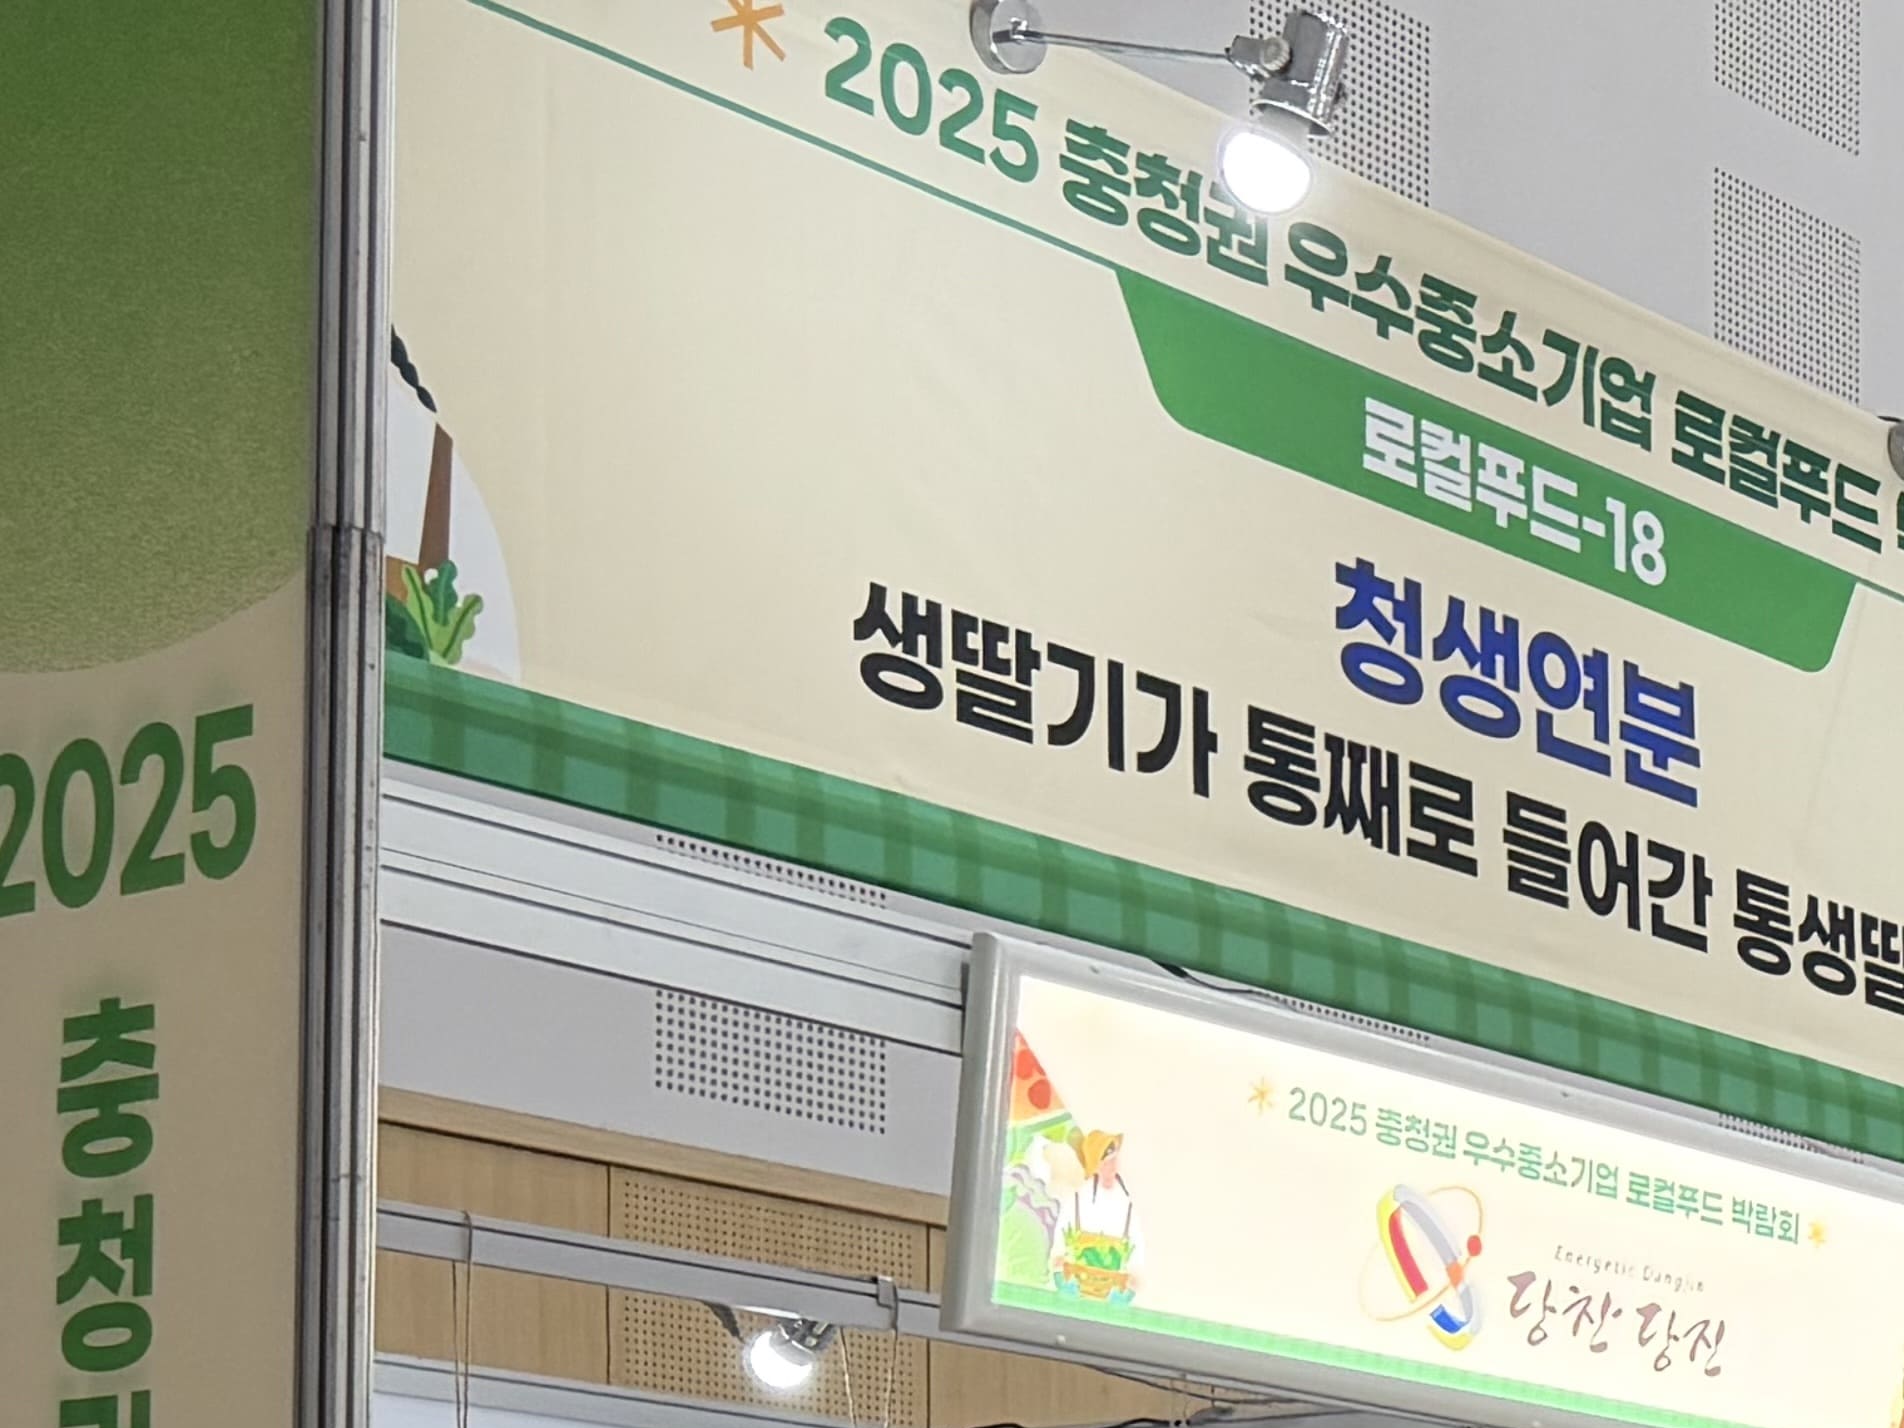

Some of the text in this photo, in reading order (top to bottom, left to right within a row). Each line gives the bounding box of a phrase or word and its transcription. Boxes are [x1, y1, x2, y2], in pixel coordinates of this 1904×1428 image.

[823, 14, 1041, 183] 2025
[1057, 119, 1270, 286] 충청권
[1284, 221, 1656, 453] 우수중소기업
[1670, 387, 1883, 554] 로컬푸드
[1363, 397, 1667, 586] 로컬푸드-18
[853, 579, 1219, 799] 생딸기가
[1242, 701, 1478, 876] 통째로
[1501, 789, 1712, 952] 들어간
[1334, 556, 1703, 807] 청생연분
[1288, 1087, 1801, 1245] 2025 충청권 우수중소기업 로컬푸드 박람회
